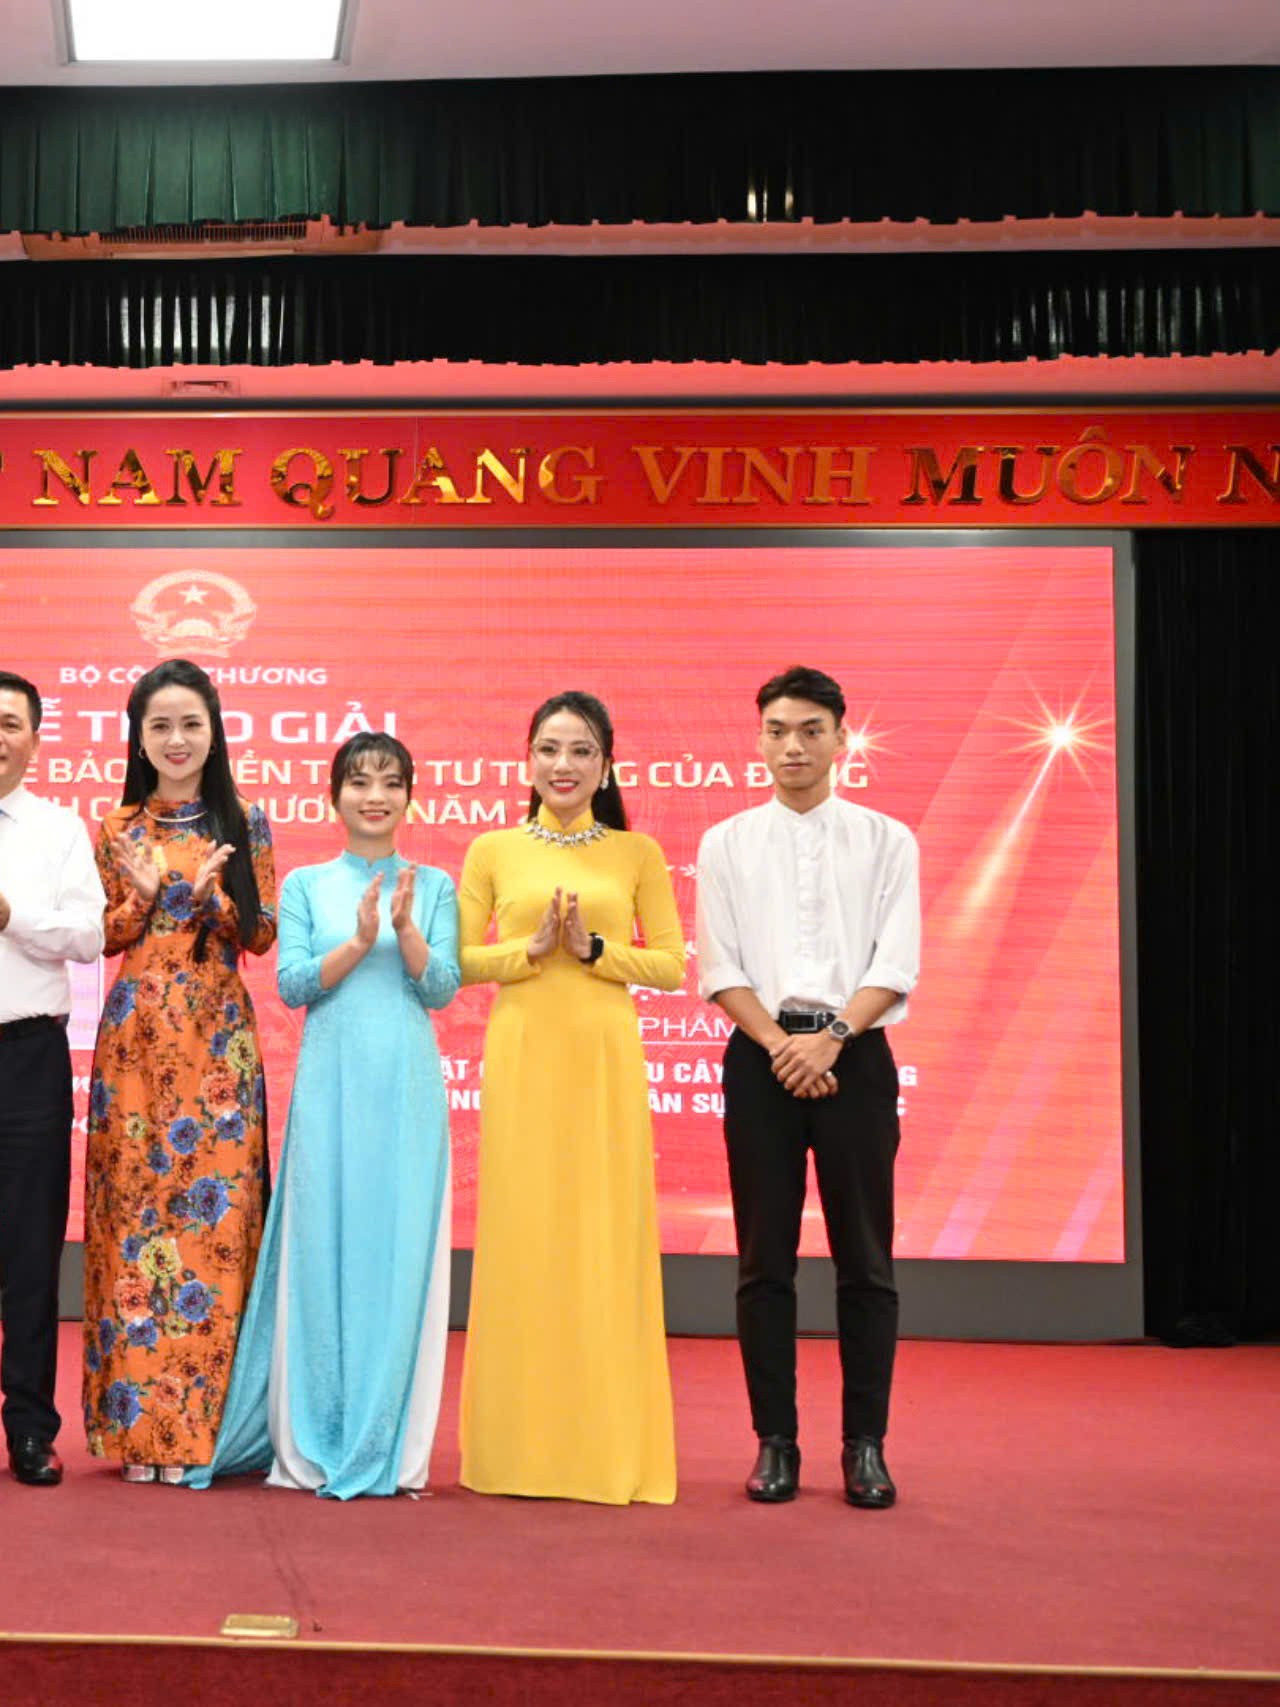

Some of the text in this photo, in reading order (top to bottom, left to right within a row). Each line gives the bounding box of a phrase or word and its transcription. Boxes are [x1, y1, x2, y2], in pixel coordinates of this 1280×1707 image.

[31, 447, 243, 505] NAM
[269, 446, 605, 519] QUANG
[632, 445, 878, 505] VINH
[901, 425, 1195, 504] MUÔN
[59, 665, 101, 688] BỘ
[271, 701, 396, 743] GIẢI
[425, 757, 483, 787] TƯ
[648, 753, 734, 788] CỦA
